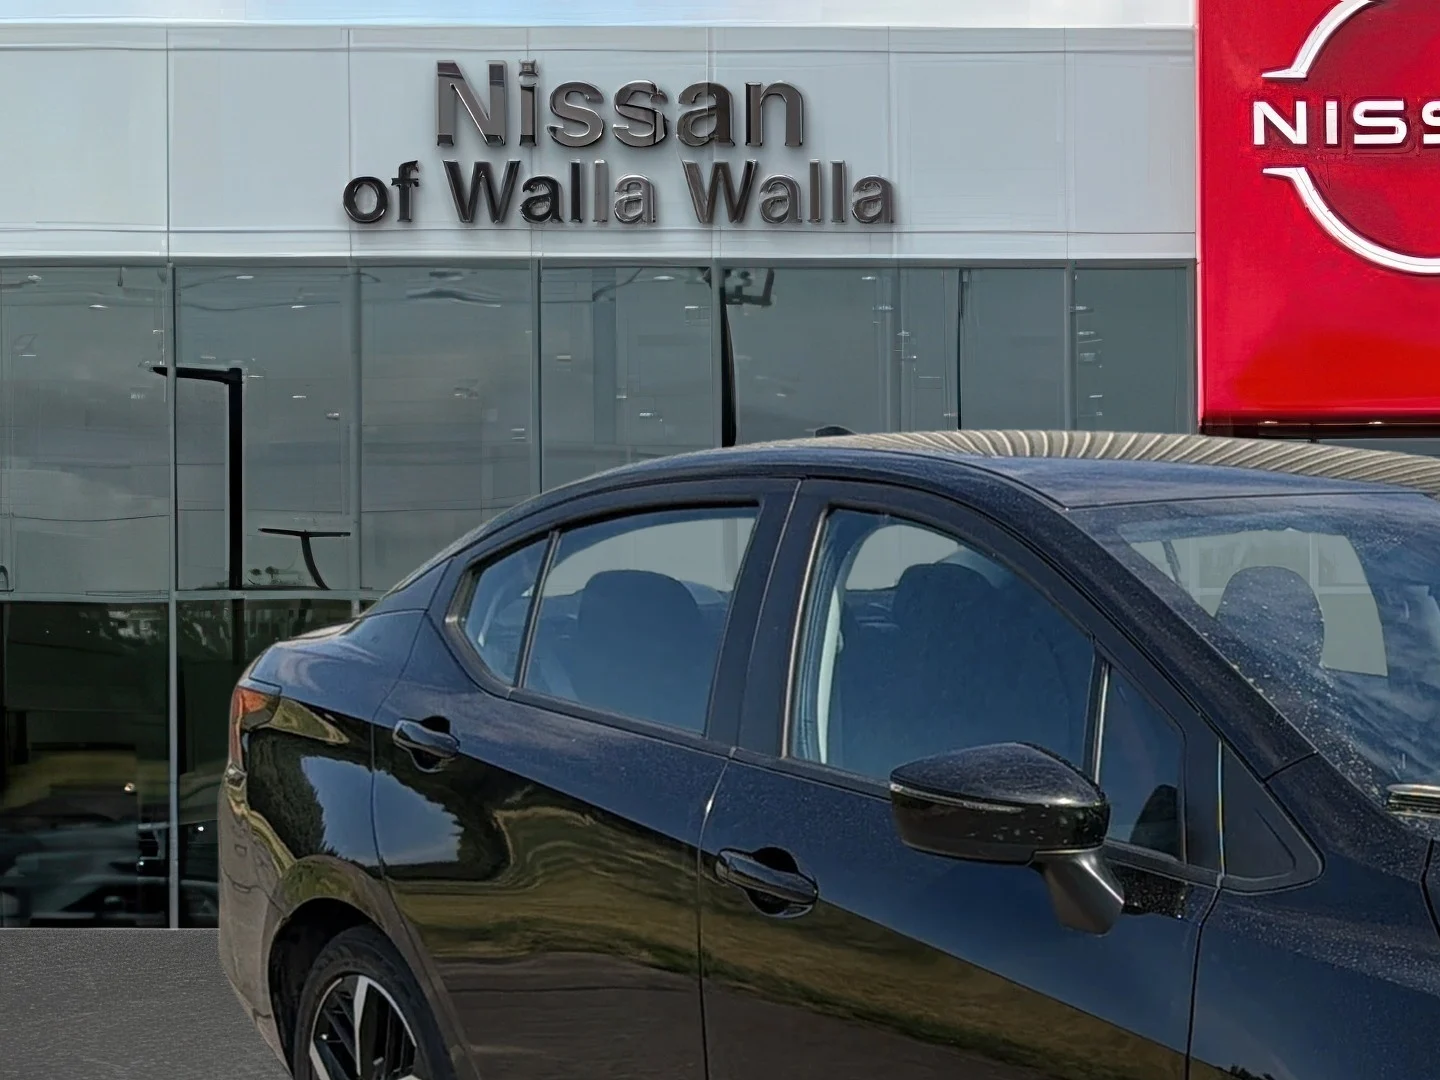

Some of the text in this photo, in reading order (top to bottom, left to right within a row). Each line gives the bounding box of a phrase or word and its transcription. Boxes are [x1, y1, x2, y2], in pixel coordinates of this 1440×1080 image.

[436, 59, 805, 148] Nissan
[342, 159, 895, 224] of Walla Walla
